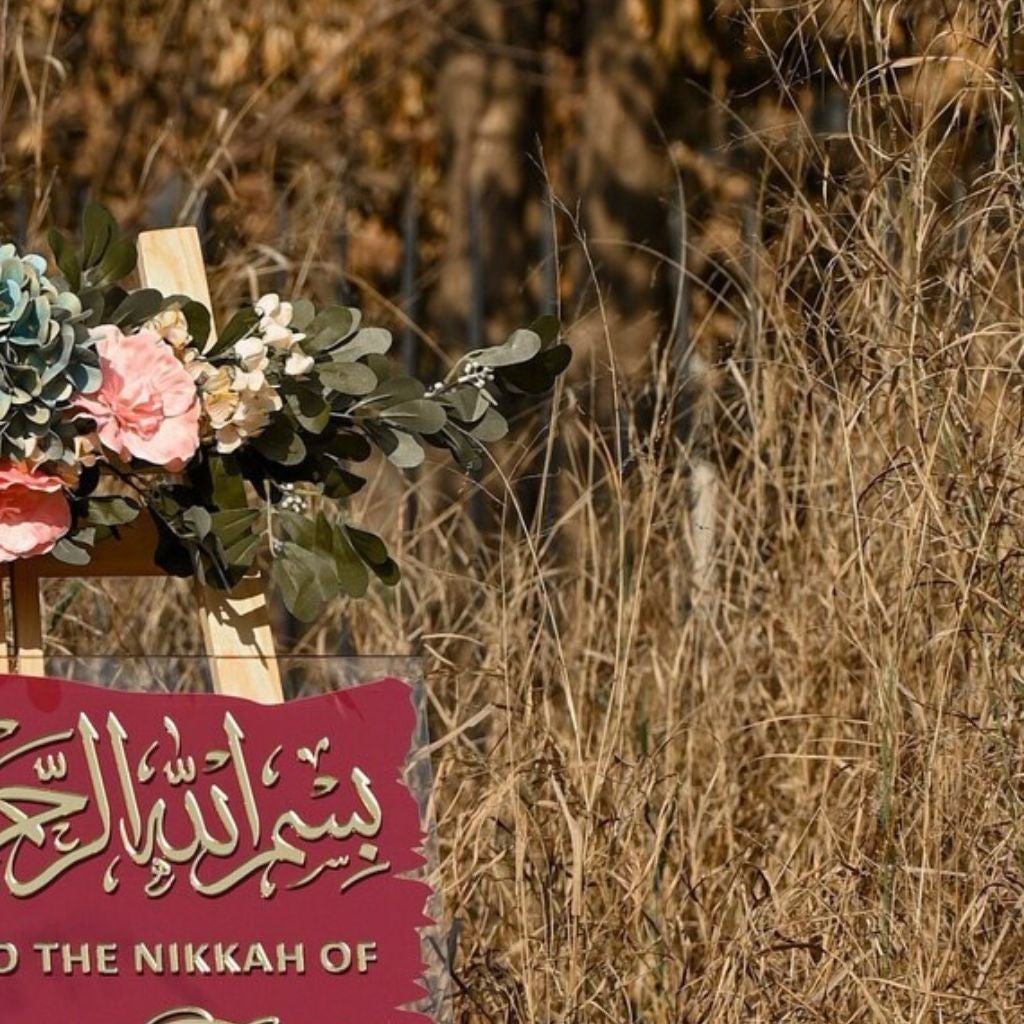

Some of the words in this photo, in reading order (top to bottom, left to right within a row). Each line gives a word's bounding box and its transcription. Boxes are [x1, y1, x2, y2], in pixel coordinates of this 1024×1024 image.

[33, 942, 119, 974] THE
[134, 942, 305, 974] NIKKAH
[320, 941, 377, 973] OF
